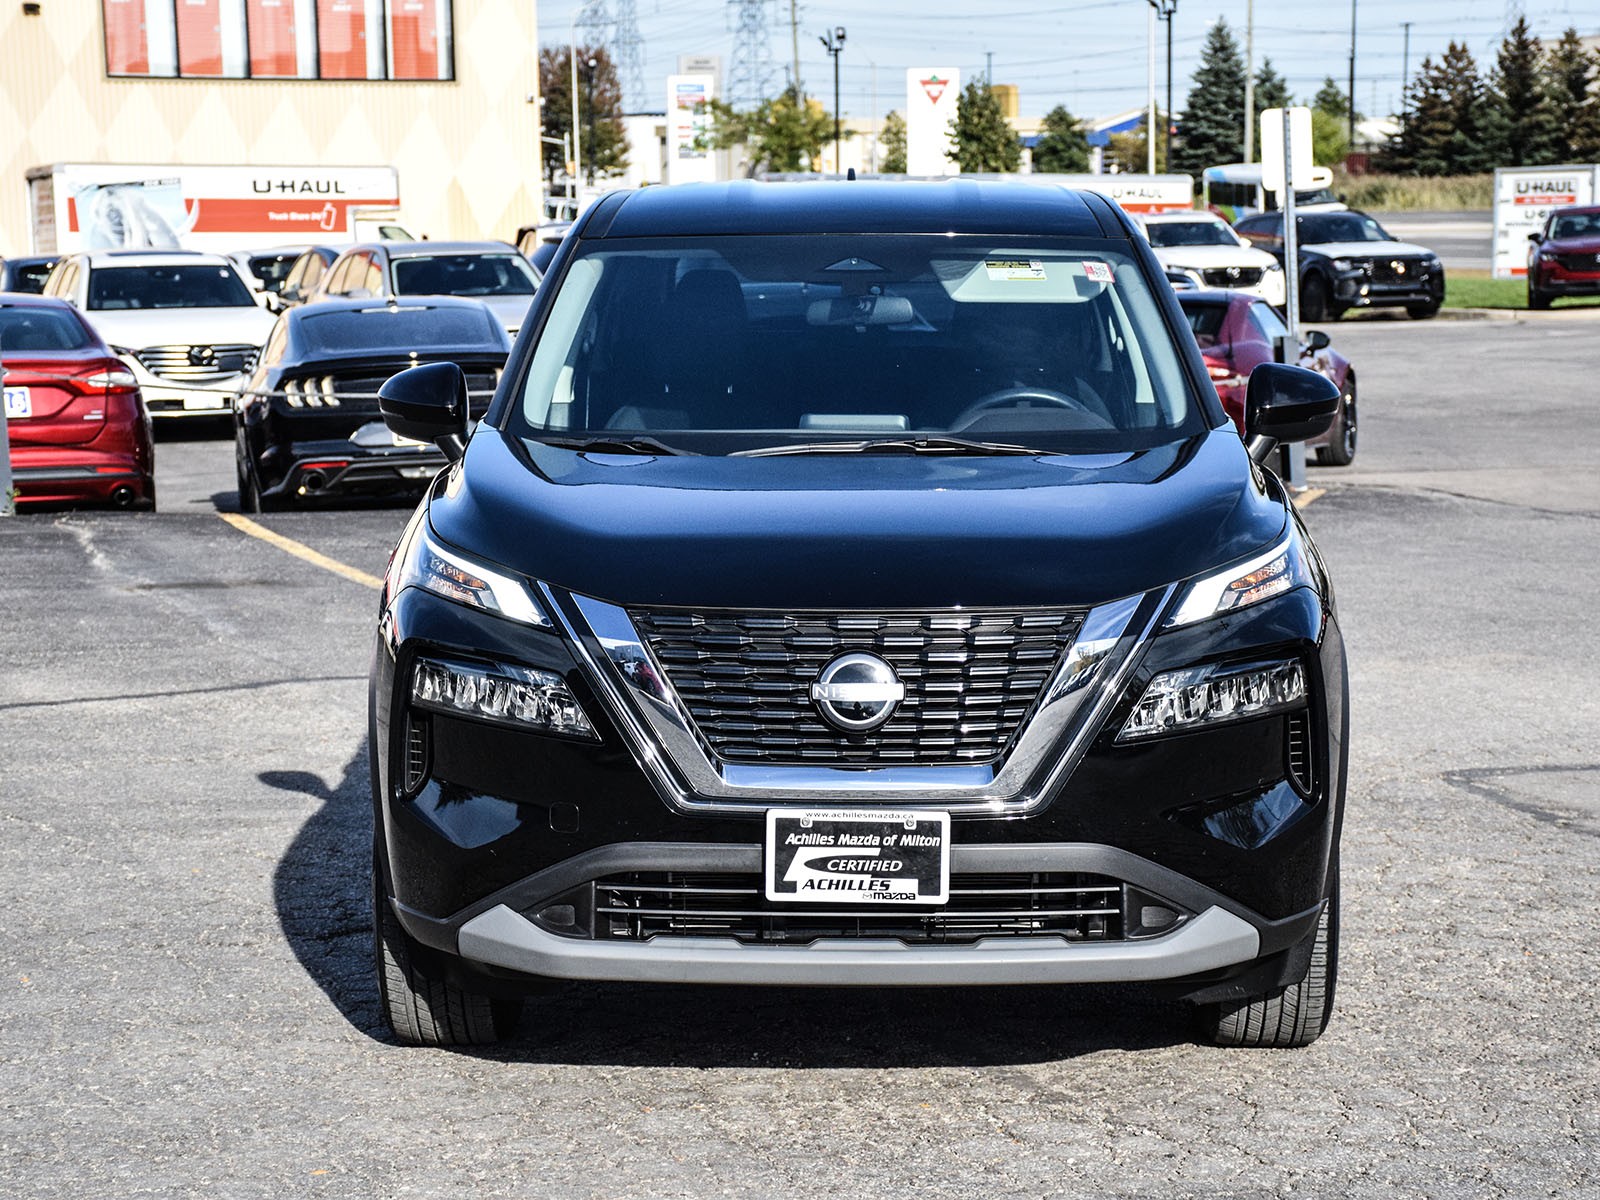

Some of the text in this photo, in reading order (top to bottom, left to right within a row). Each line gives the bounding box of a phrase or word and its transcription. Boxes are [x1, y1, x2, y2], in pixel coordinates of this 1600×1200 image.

[805, 811, 915, 820] www.achillesmazda.ca
[785, 833, 941, 847] Achilles Mazda of Milton
[826, 859, 903, 872] CERTIFIED
[802, 878, 891, 892] ACHILLES
